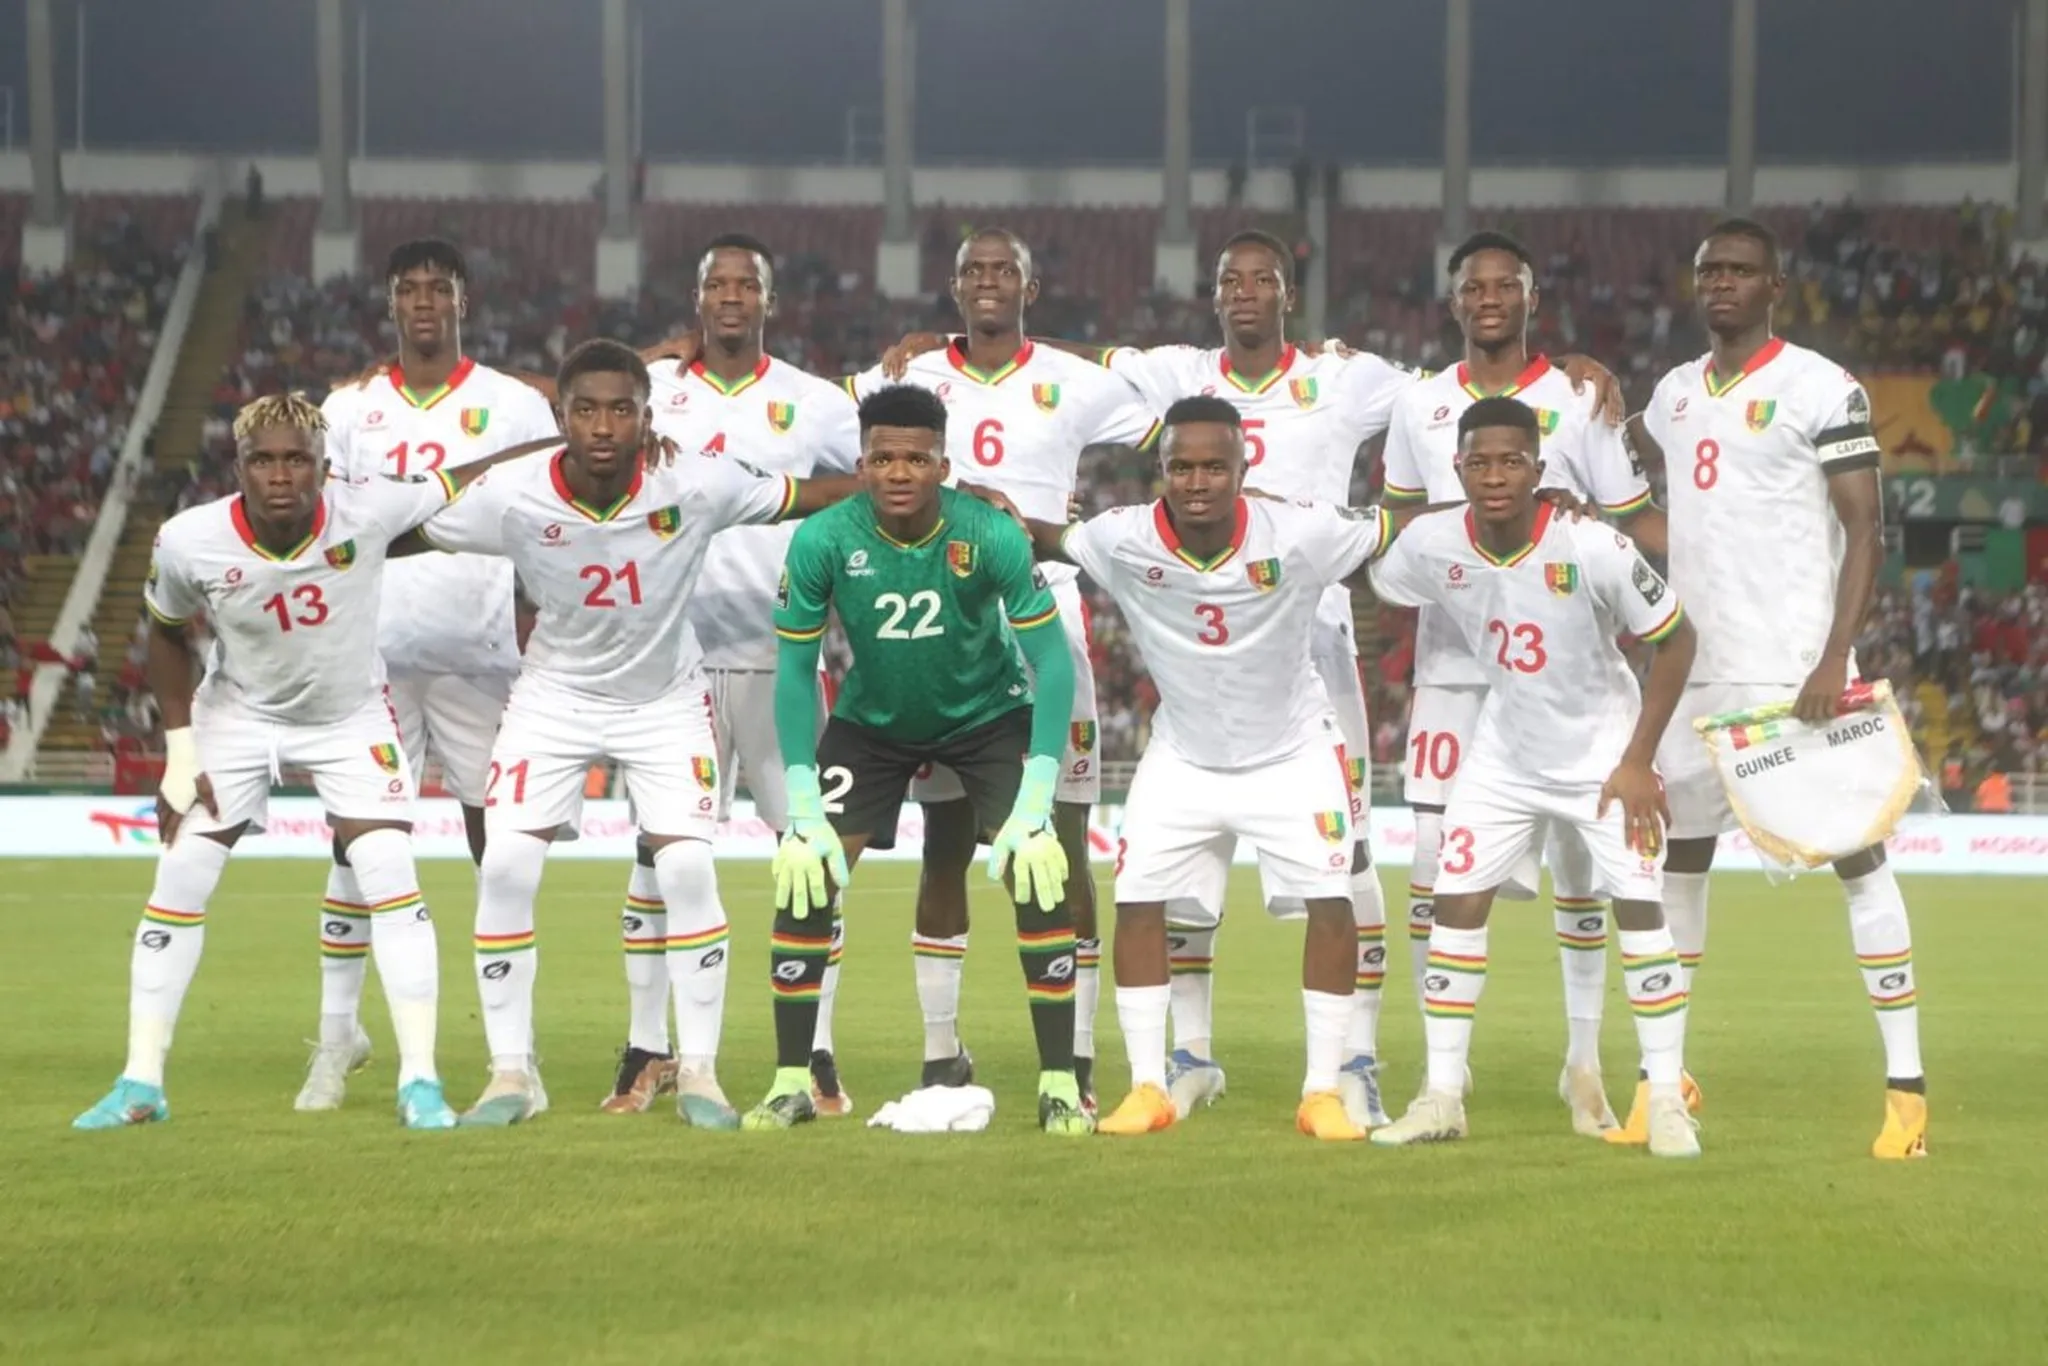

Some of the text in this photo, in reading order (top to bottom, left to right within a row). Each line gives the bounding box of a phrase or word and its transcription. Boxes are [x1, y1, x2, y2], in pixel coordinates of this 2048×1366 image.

[973, 418, 1004, 467] 6
[1239, 419, 1265, 467] 5
[1694, 438, 1719, 490] 8
[1890, 478, 1937, 517] 12
[263, 583, 329, 632] 13
[579, 560, 642, 606] 21
[874, 590, 945, 639] 22
[1194, 603, 1230, 646] 3
[1488, 618, 1547, 673] 23
[1410, 731, 1460, 781] 10
[1734, 716, 1886, 779] GUINEE MAROC
[484, 759, 529, 806] 21
[815, 762, 854, 813] 2
[1438, 827, 1475, 875] 3
